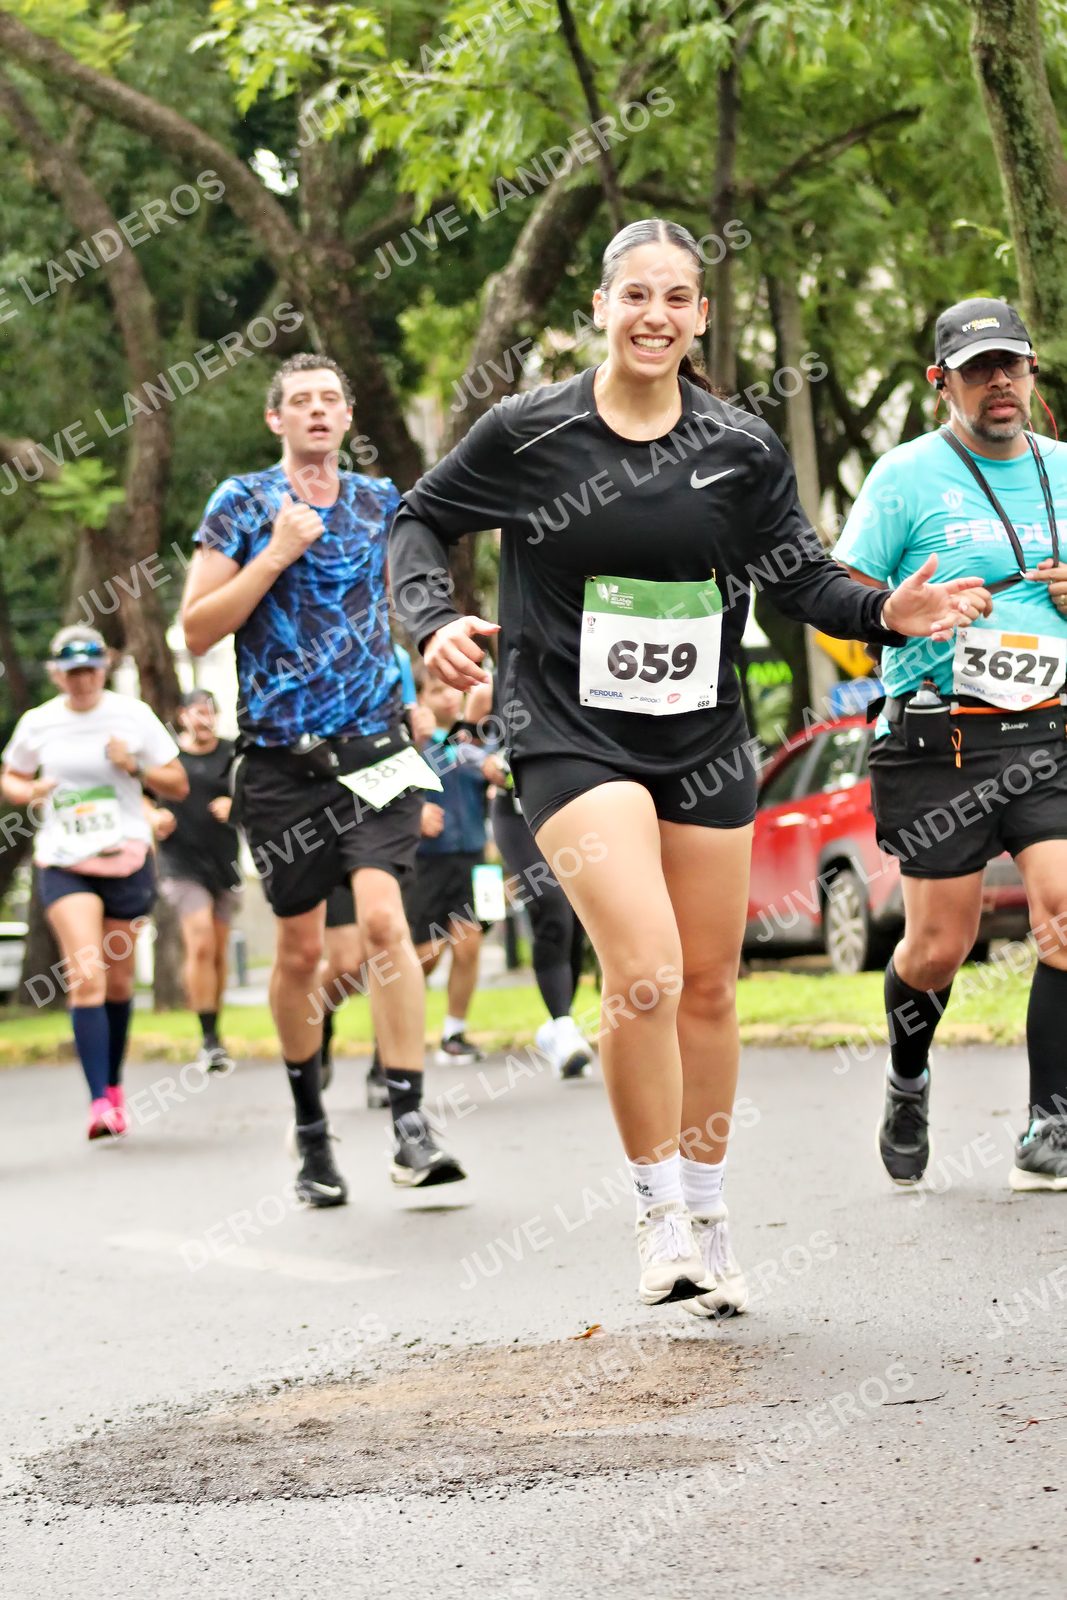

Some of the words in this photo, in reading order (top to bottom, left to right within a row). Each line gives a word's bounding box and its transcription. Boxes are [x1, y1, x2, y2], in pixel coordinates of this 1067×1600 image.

[607, 639, 698, 684] 659
[961, 646, 1060, 687] 3627
[589, 688, 624, 698] PERDURA
[697, 700, 710, 708] 659
